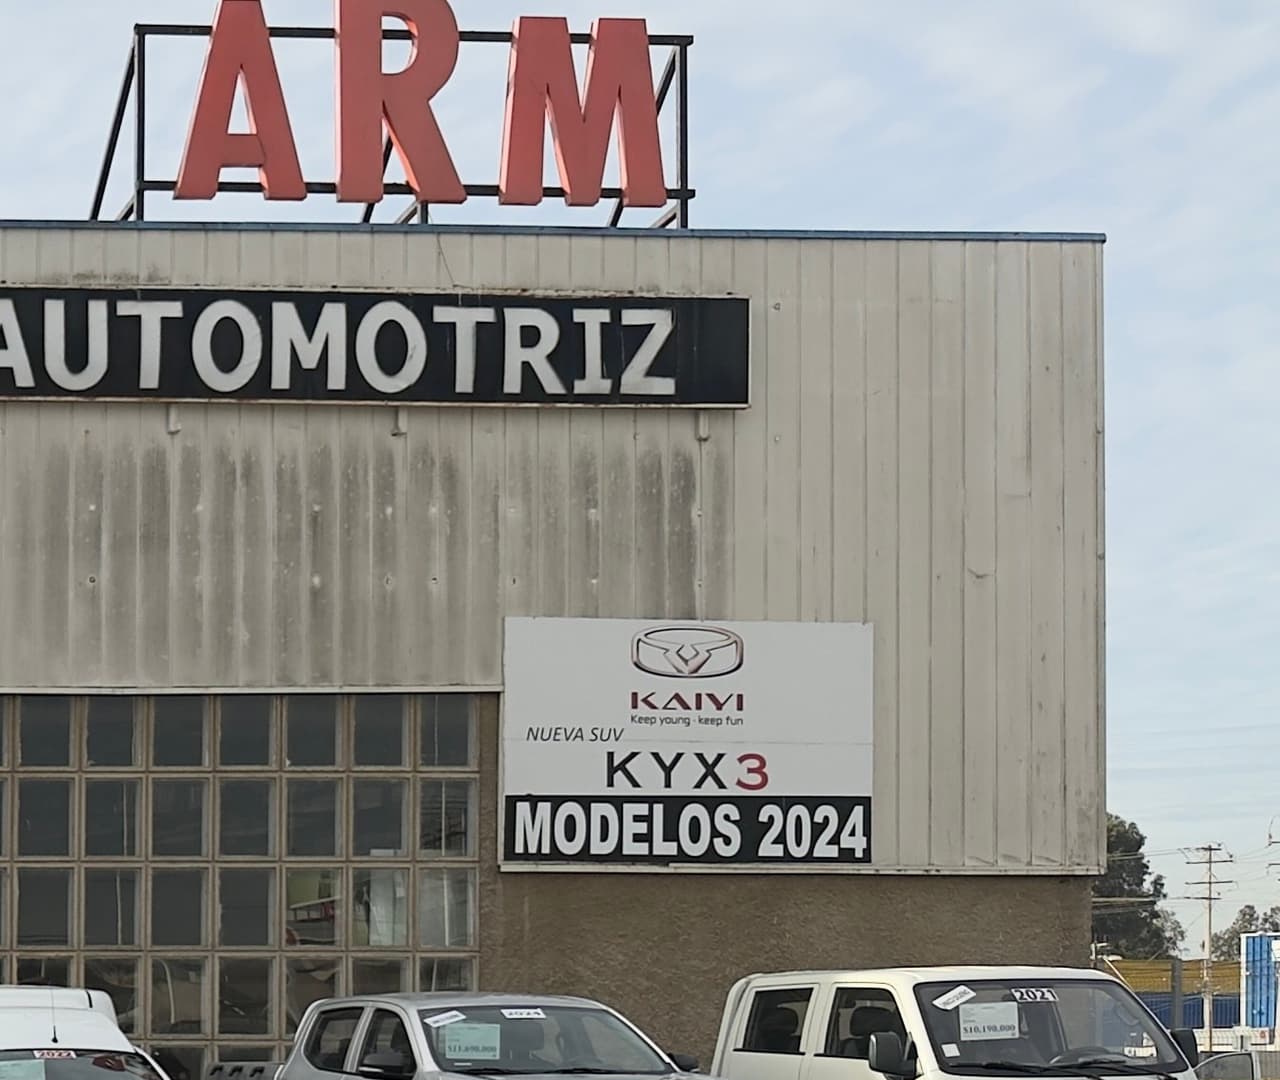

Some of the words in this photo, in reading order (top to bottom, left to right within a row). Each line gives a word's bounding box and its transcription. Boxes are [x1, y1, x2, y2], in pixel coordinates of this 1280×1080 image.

[173, 0, 668, 208] ARM
[526, 726, 584, 742] NUEVA
[590, 727, 624, 742] SUV
[630, 714, 657, 726] Keep
[659, 716, 691, 727] young
[698, 715, 723, 727] keep
[726, 715, 744, 726] fun
[606, 751, 769, 791] KYX3
[514, 801, 742, 858] MODELOS
[757, 803, 867, 859] 2024
[1015, 989, 1058, 1001] 2021
